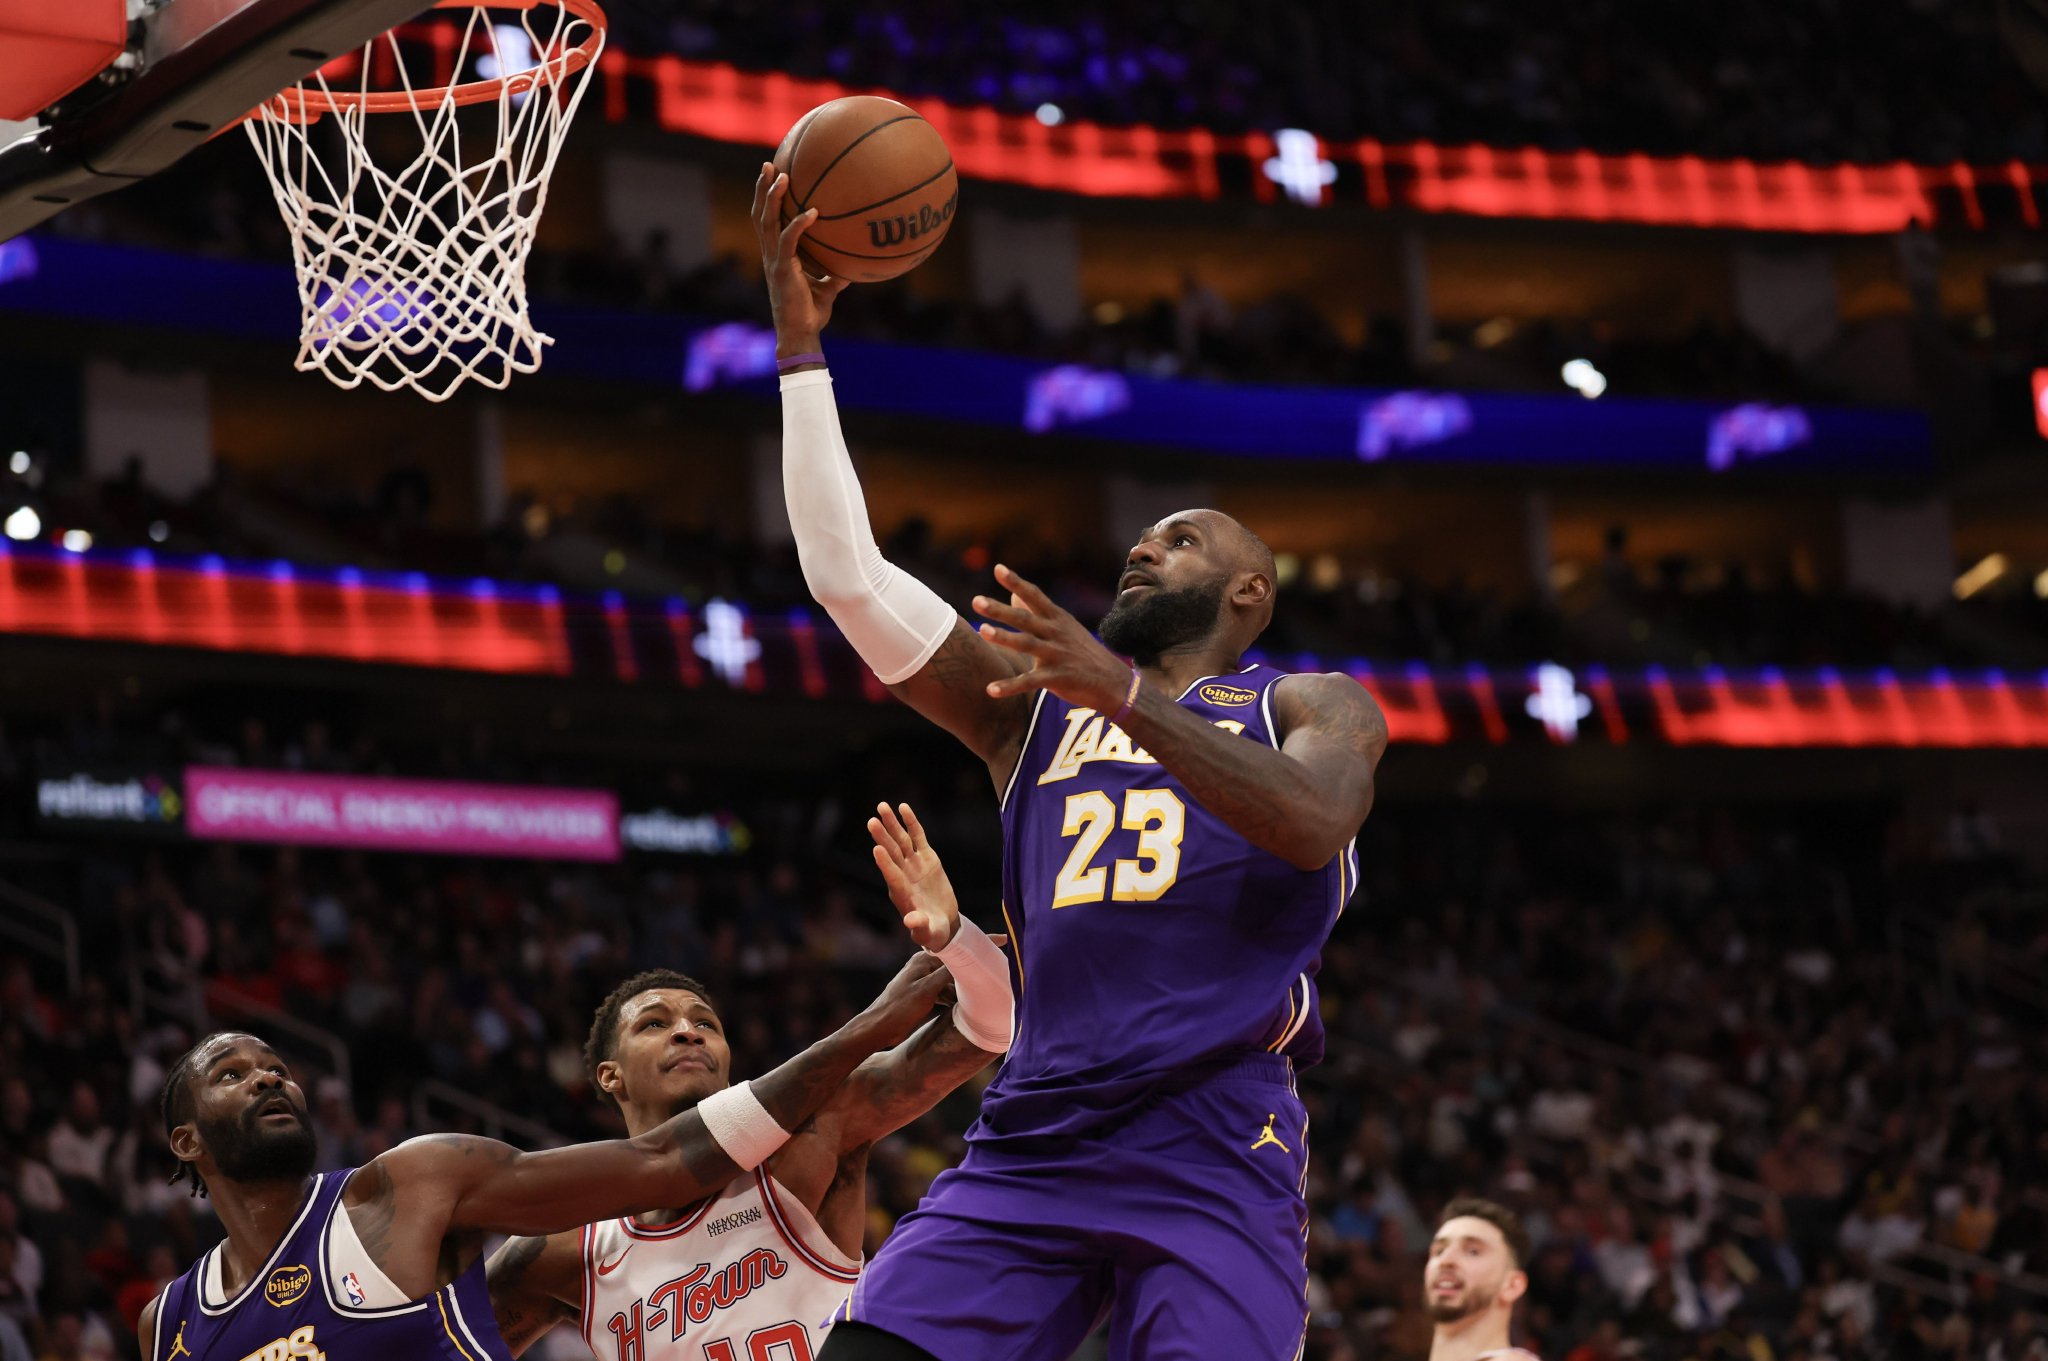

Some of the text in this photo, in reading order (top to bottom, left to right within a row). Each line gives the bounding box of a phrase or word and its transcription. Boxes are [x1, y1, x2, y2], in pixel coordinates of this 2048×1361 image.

[1205, 687, 1254, 702] bibigo
[1037, 707, 1246, 785] LAK
[1052, 788, 1186, 909] 23
[706, 1206, 761, 1231] MEMORIAL
[708, 1211, 762, 1238] HERMANN
[268, 1273, 308, 1293] bibigo
[607, 1247, 788, 1361] H-Town
